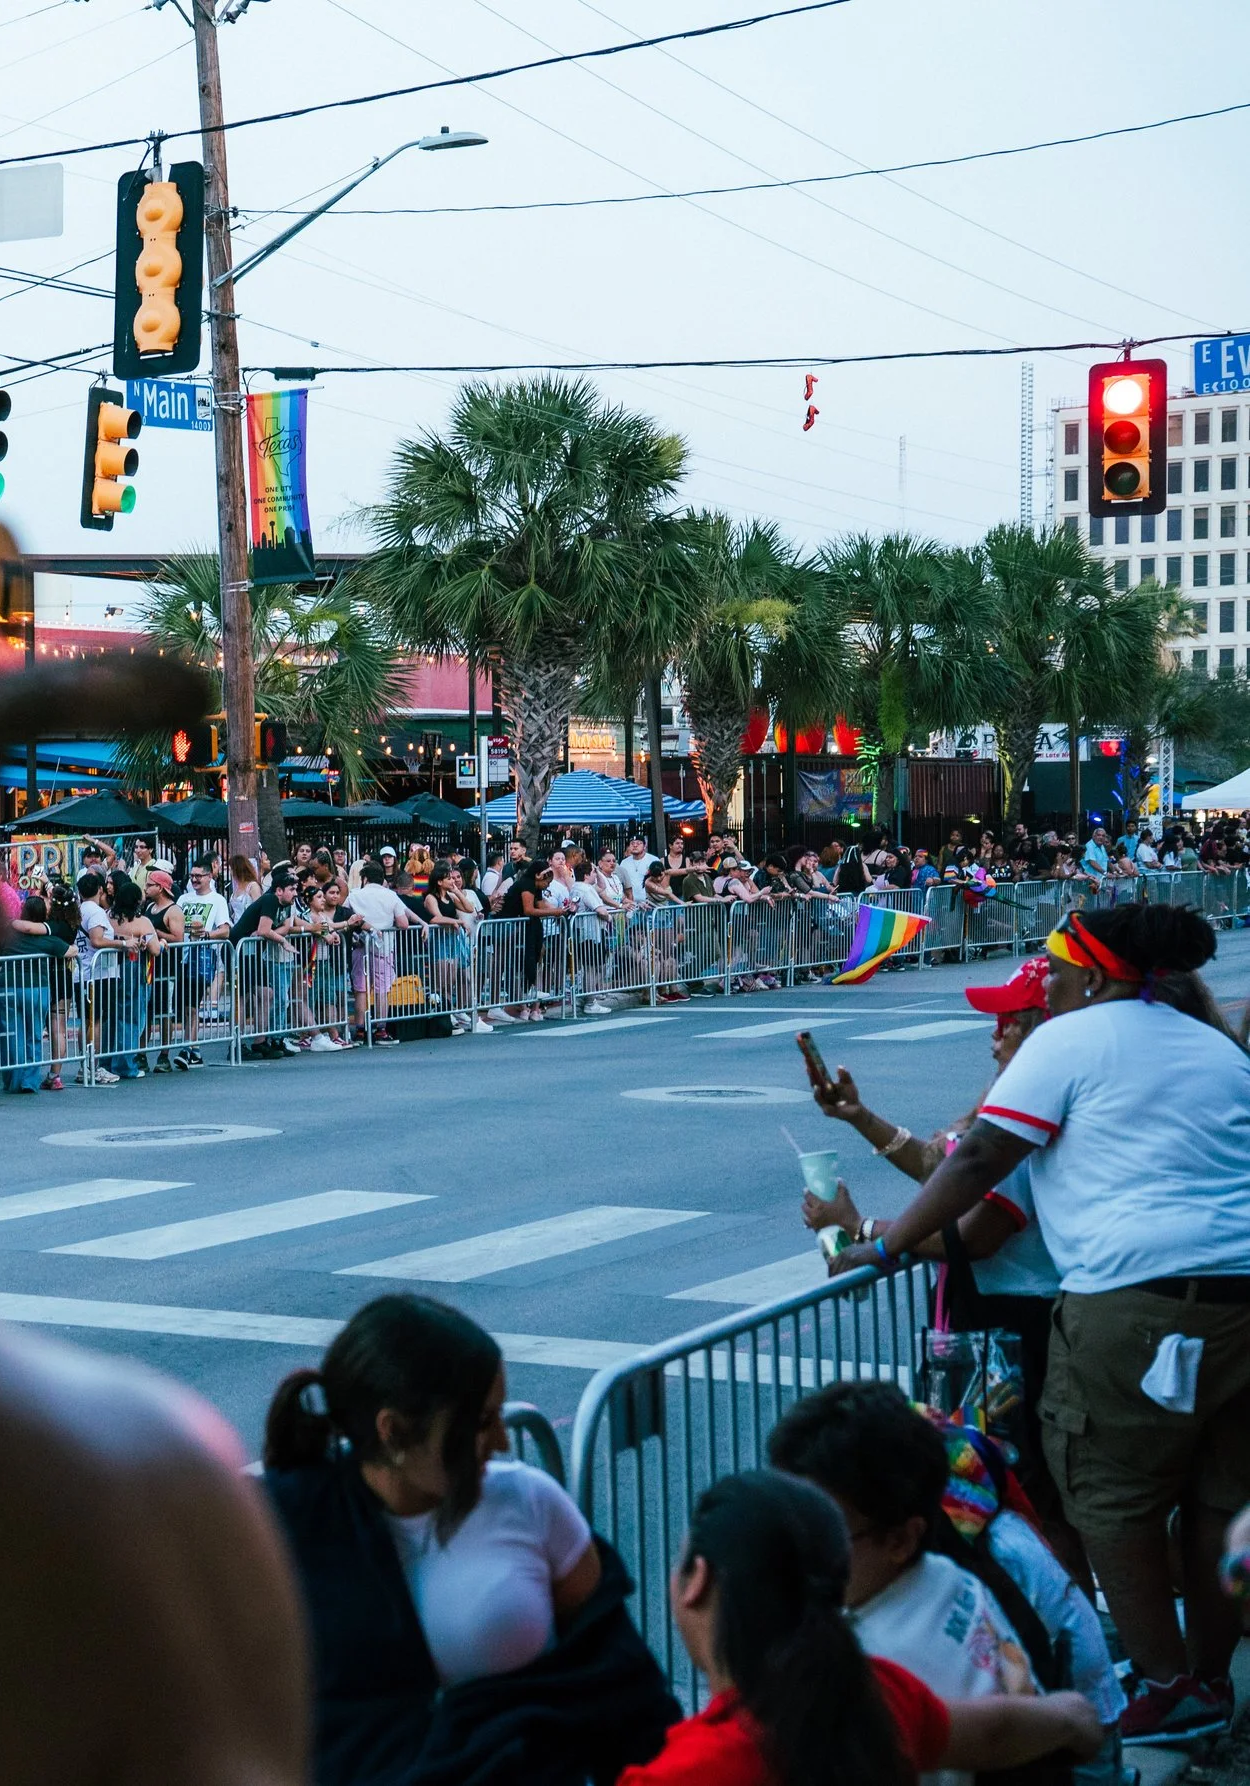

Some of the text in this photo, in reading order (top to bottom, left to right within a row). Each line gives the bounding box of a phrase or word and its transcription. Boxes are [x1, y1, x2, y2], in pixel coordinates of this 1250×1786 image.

[1202, 343, 1211, 363] E
[1202, 382, 1211, 393] E
[133, 381, 189, 420] N Main
[191, 420, 208, 431] 1400
[259, 426, 300, 459] Texas
[253, 497, 266, 505] ONE
